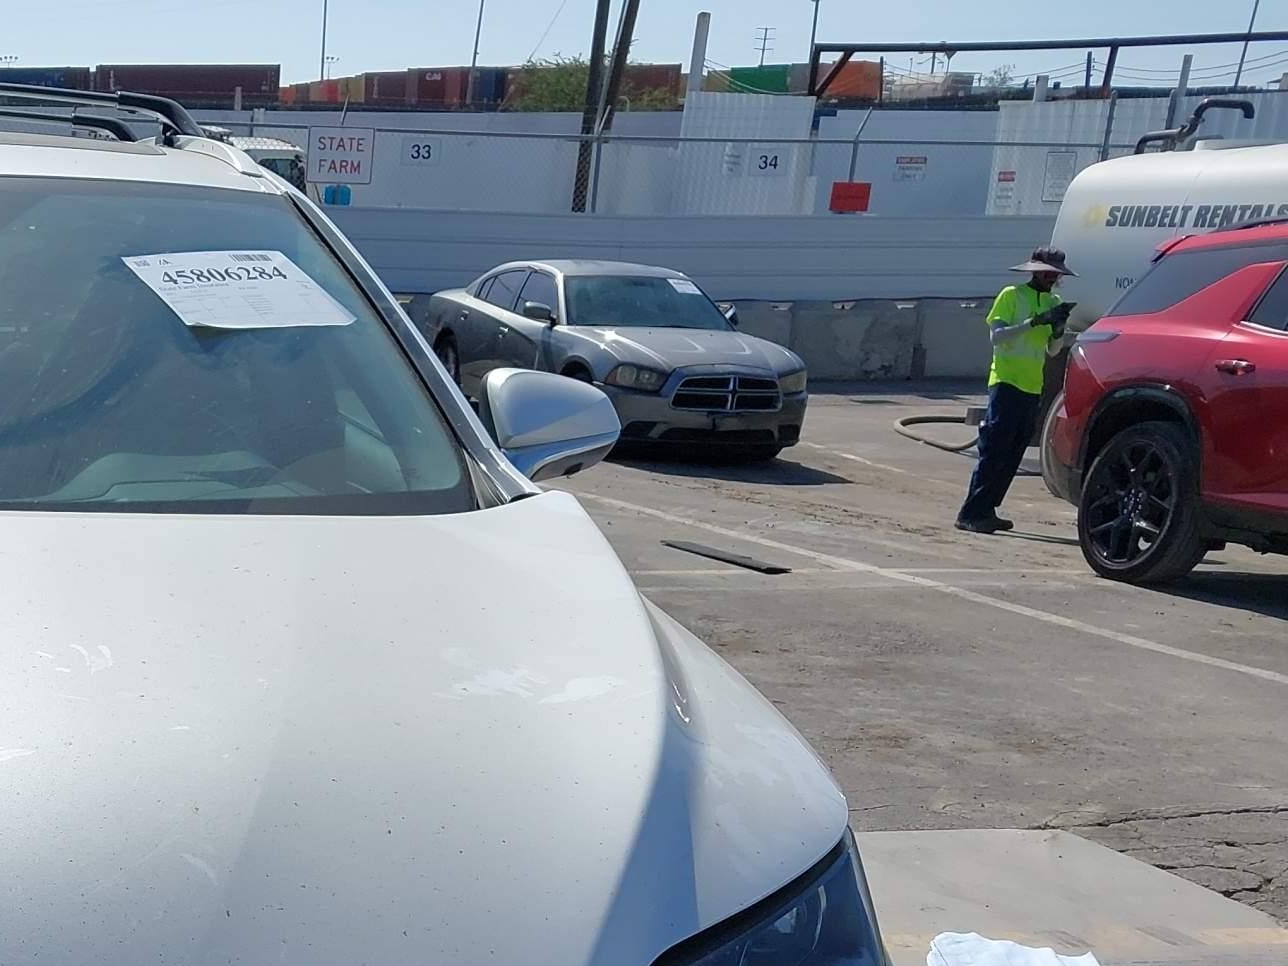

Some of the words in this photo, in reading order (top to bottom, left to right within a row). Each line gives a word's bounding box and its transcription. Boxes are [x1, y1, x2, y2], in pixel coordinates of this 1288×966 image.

[317, 136, 366, 152] STATE
[410, 144, 432, 160] 33
[317, 159, 361, 175] FARM
[758, 154, 779, 170] 34
[1105, 205, 1193, 228] SUNBELT
[161, 265, 288, 285] 45806284
